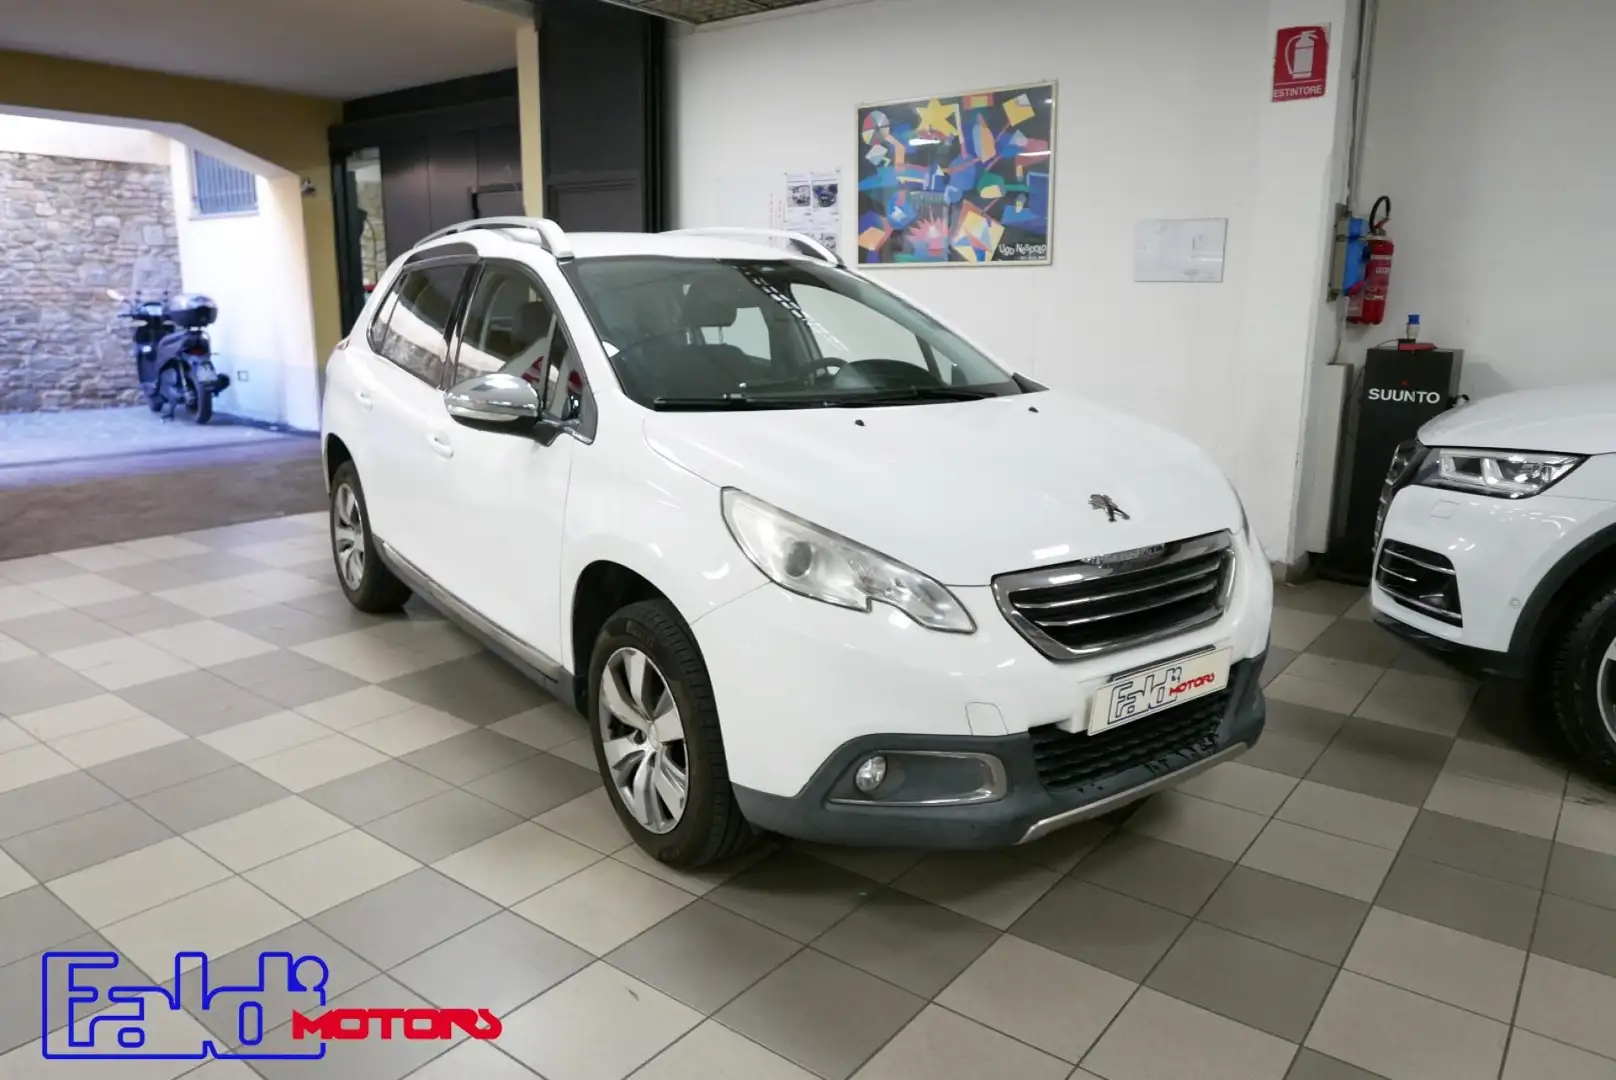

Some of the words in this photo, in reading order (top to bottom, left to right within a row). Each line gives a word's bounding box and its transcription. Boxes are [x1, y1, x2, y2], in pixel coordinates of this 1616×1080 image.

[1274, 85, 1323, 98] ESTINTORE
[999, 243, 1014, 256] Ugo
[1368, 388, 1440, 404] SUUNTO
